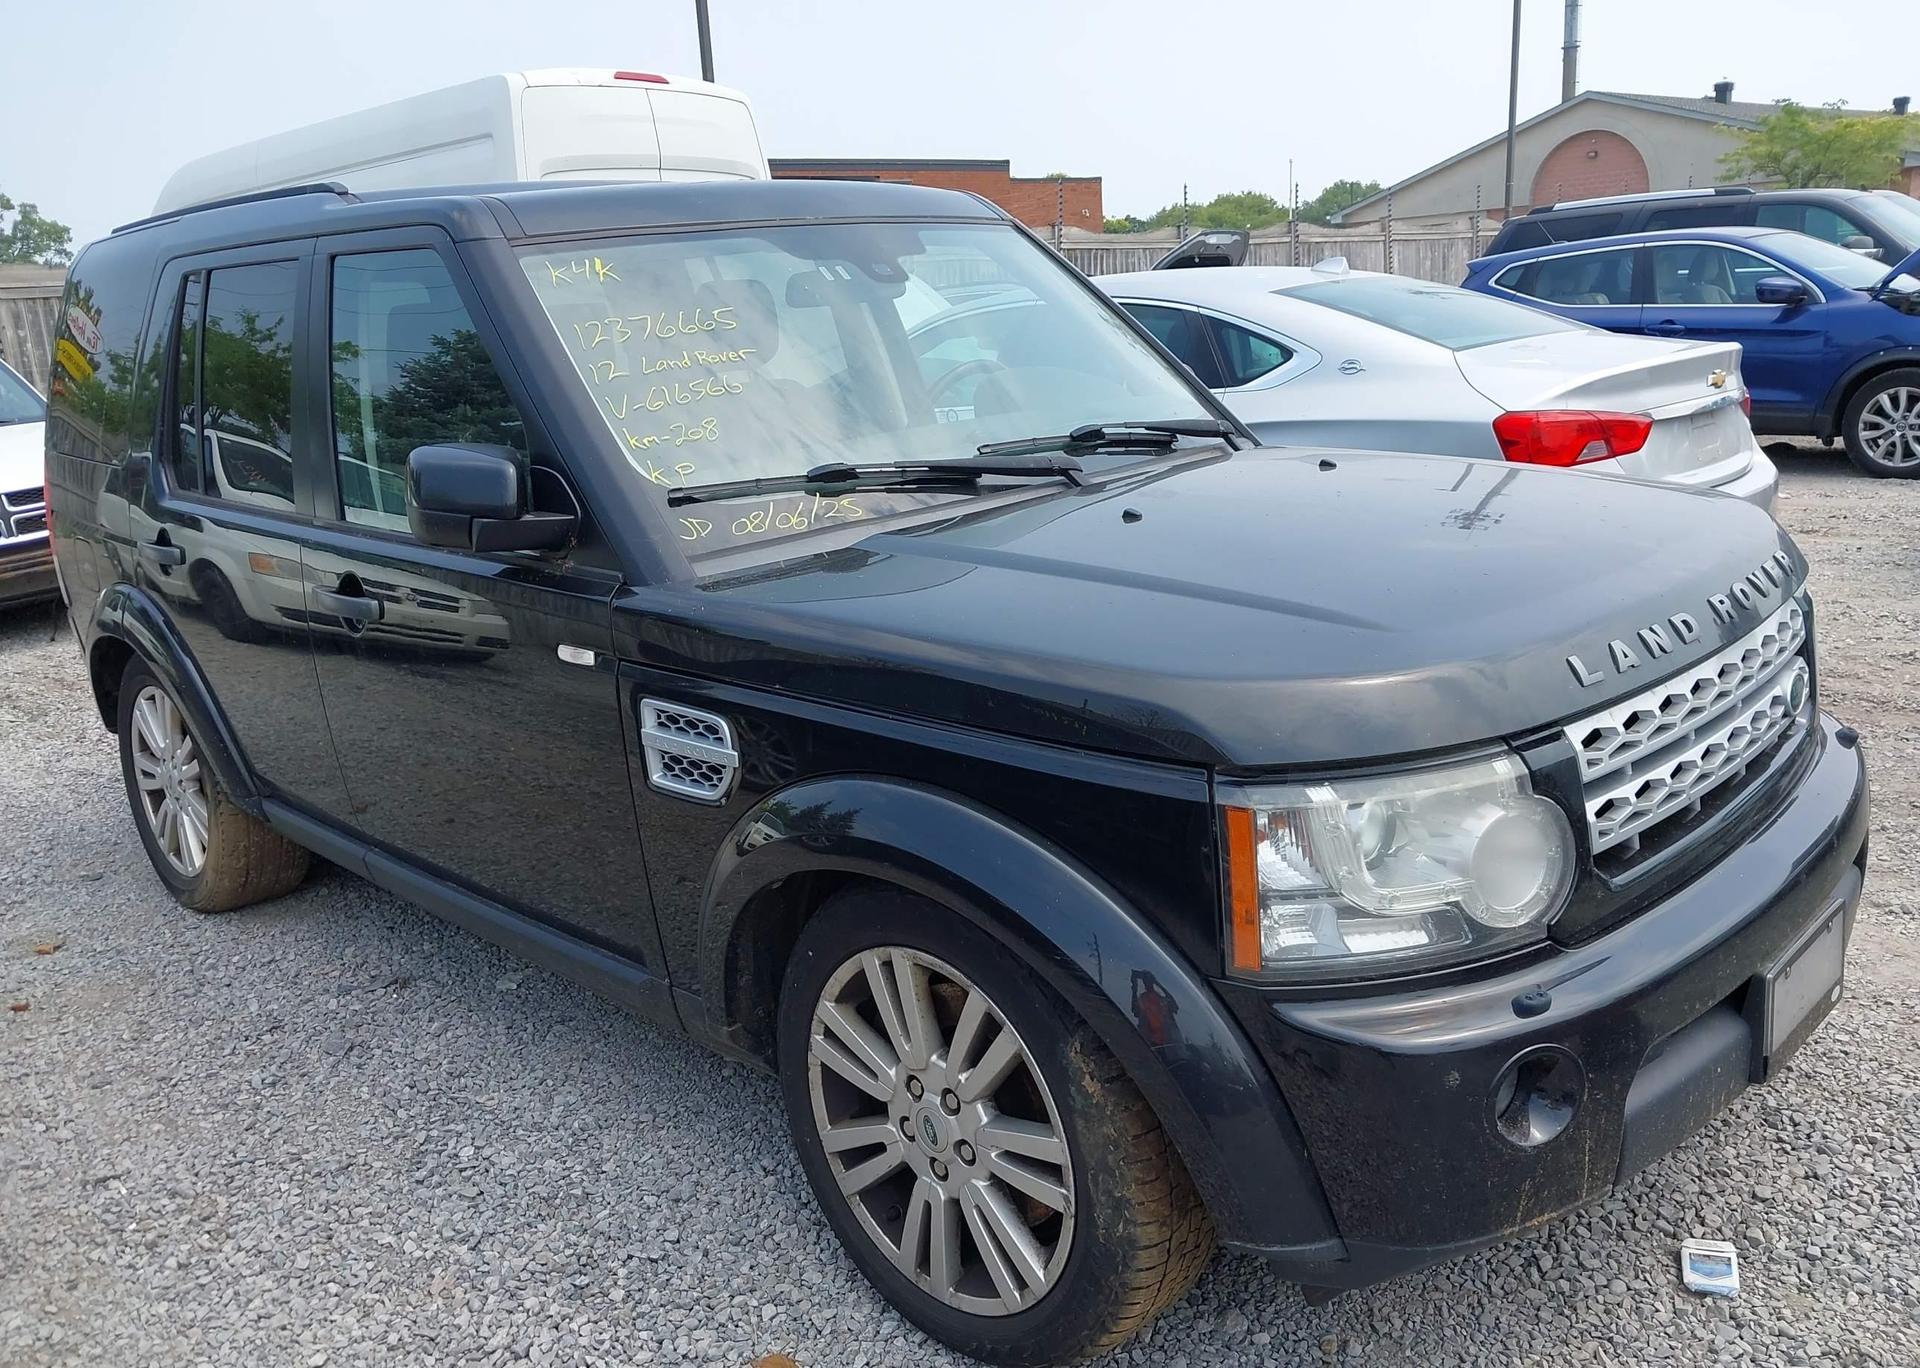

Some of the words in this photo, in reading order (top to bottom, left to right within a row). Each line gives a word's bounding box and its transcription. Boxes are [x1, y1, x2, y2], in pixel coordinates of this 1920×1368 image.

[573, 306, 737, 351] 12376665
[588, 360, 631, 385] 12
[641, 350, 692, 375] Land
[694, 349, 758, 367] Rover
[731, 491, 863, 536] 08/06/25
[1565, 611, 1701, 688] LAND
[1705, 549, 1795, 626] ROVER
